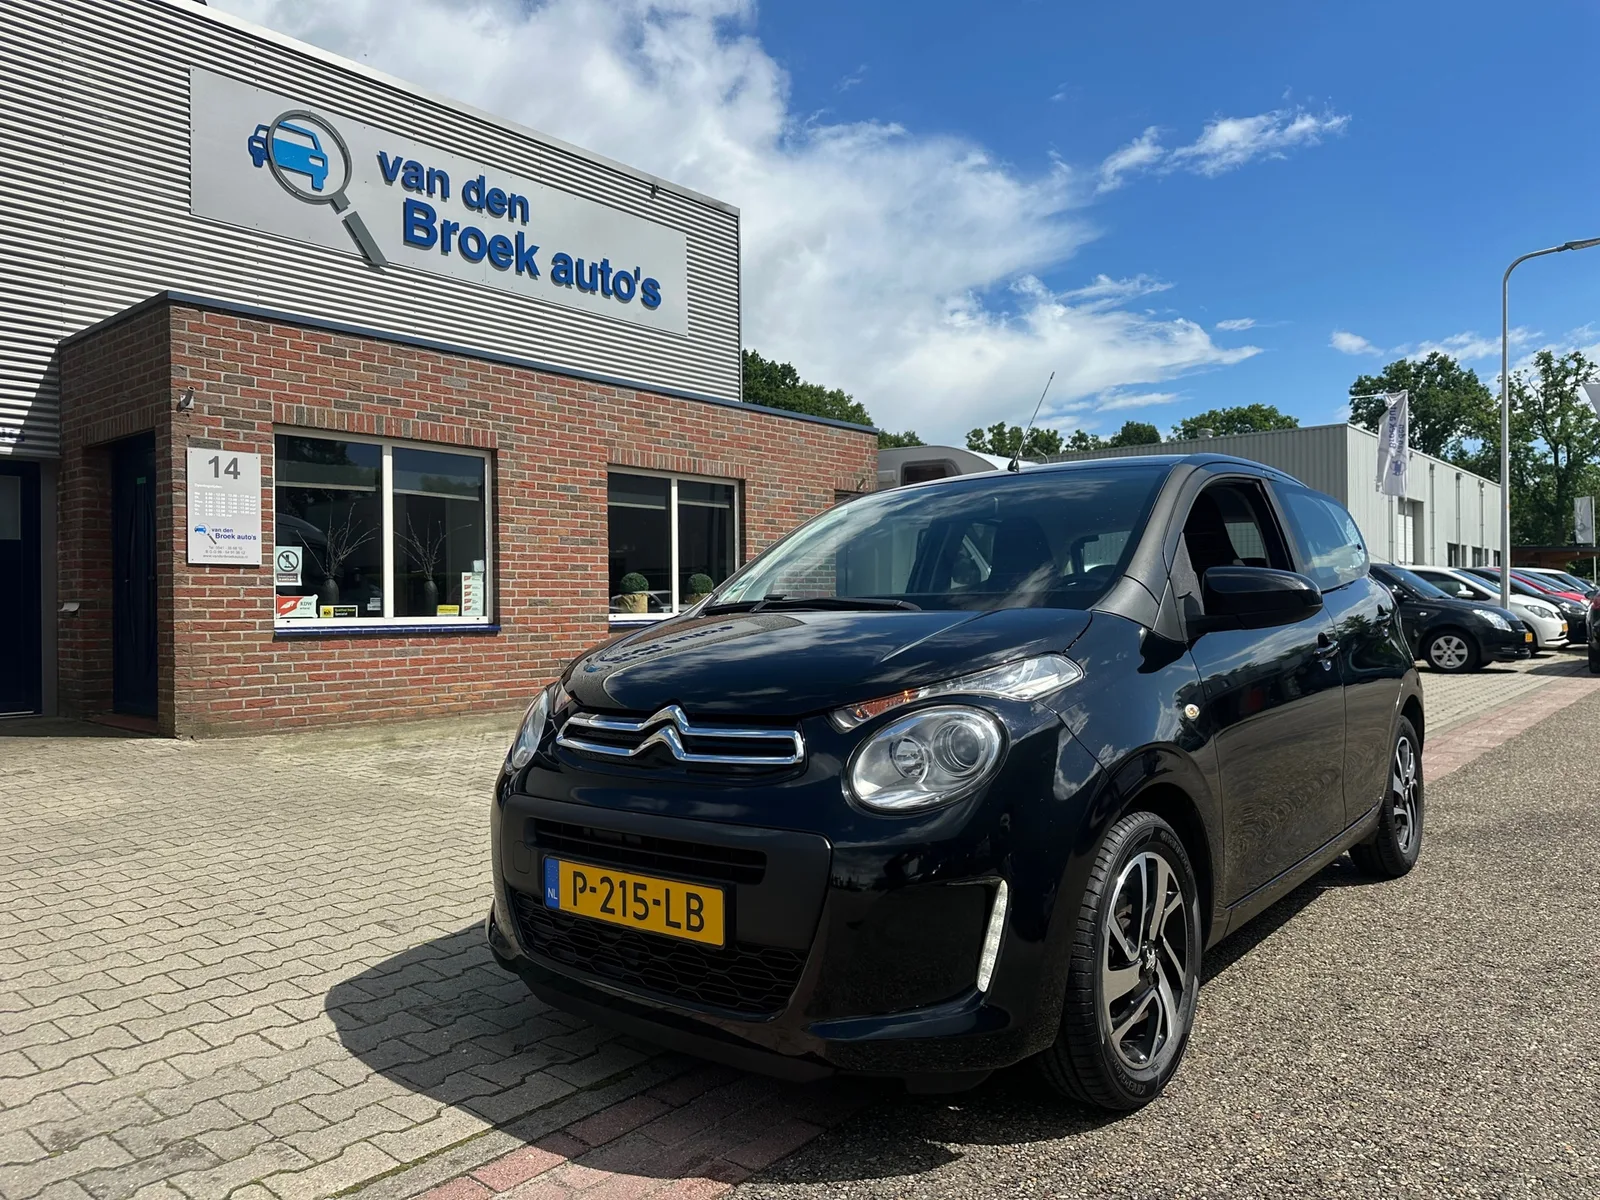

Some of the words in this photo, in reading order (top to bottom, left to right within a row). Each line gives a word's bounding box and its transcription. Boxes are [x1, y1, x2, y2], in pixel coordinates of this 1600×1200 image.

[377, 151, 450, 202] van
[462, 175, 529, 226] den
[404, 198, 540, 280] Broek
[551, 251, 662, 309] auto's
[208, 455, 241, 480] 14
[215, 532, 236, 540] Broek
[547, 886, 558, 900] NL
[572, 870, 705, 933] P-215-LB
